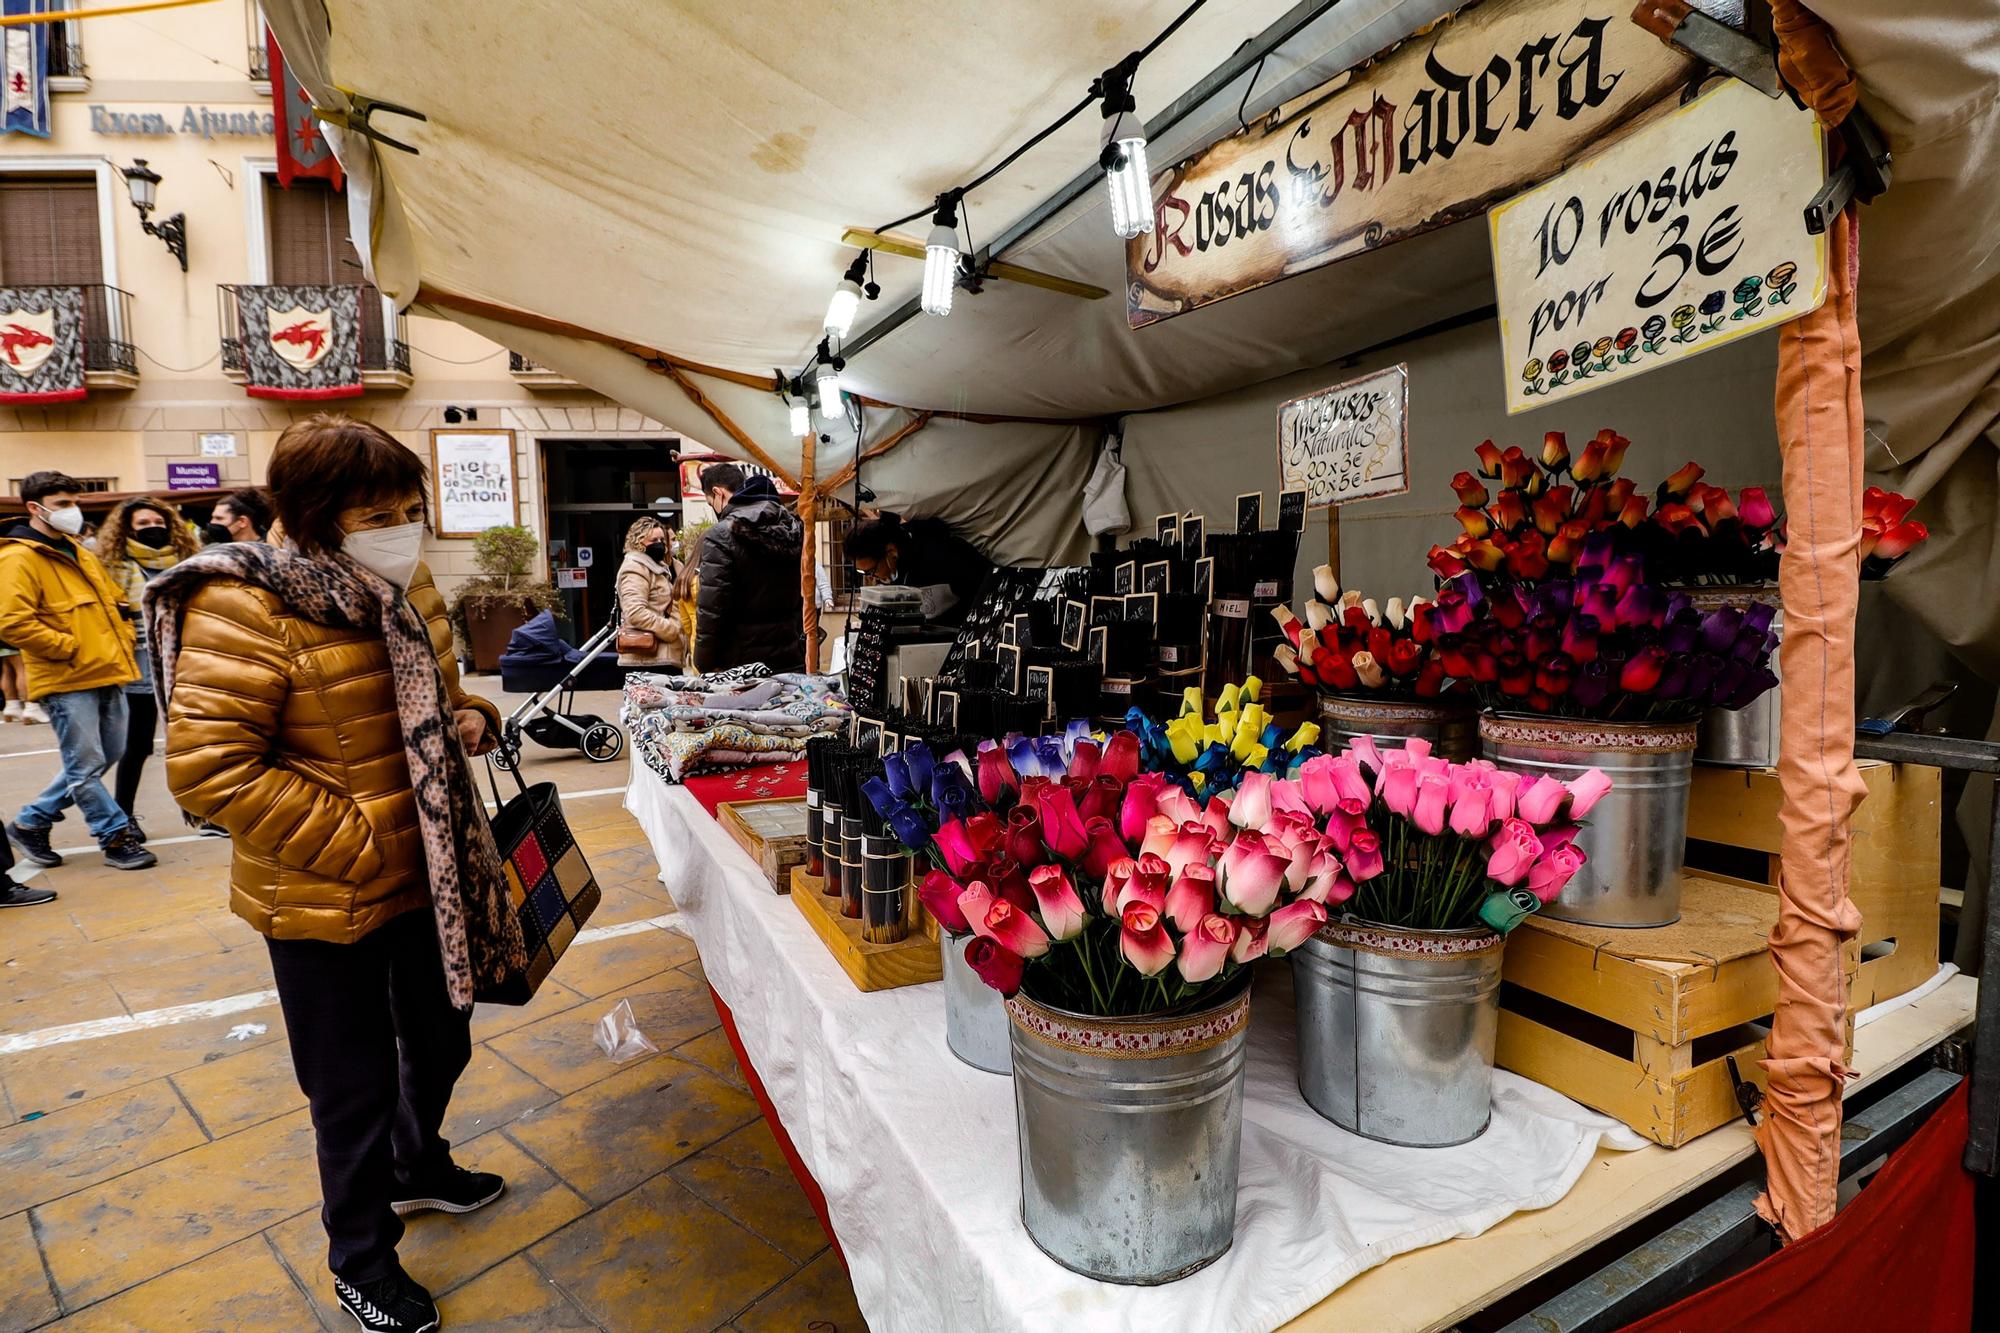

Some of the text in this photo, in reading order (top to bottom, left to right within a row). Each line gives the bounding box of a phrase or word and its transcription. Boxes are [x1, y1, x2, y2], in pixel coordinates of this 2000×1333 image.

[1144, 160, 1280, 273] Rosas
[1321, 15, 1626, 208] Madera
[1533, 130, 1739, 280] 10 rosas
[1528, 204, 1745, 358] por 3€
[175, 466, 209, 476] Municipi
[1307, 452, 1362, 480] 20 x 3€
[1339, 472, 1361, 491] 5€
[445, 488, 508, 503] Antoni
[1219, 603, 1241, 614] MIEL
